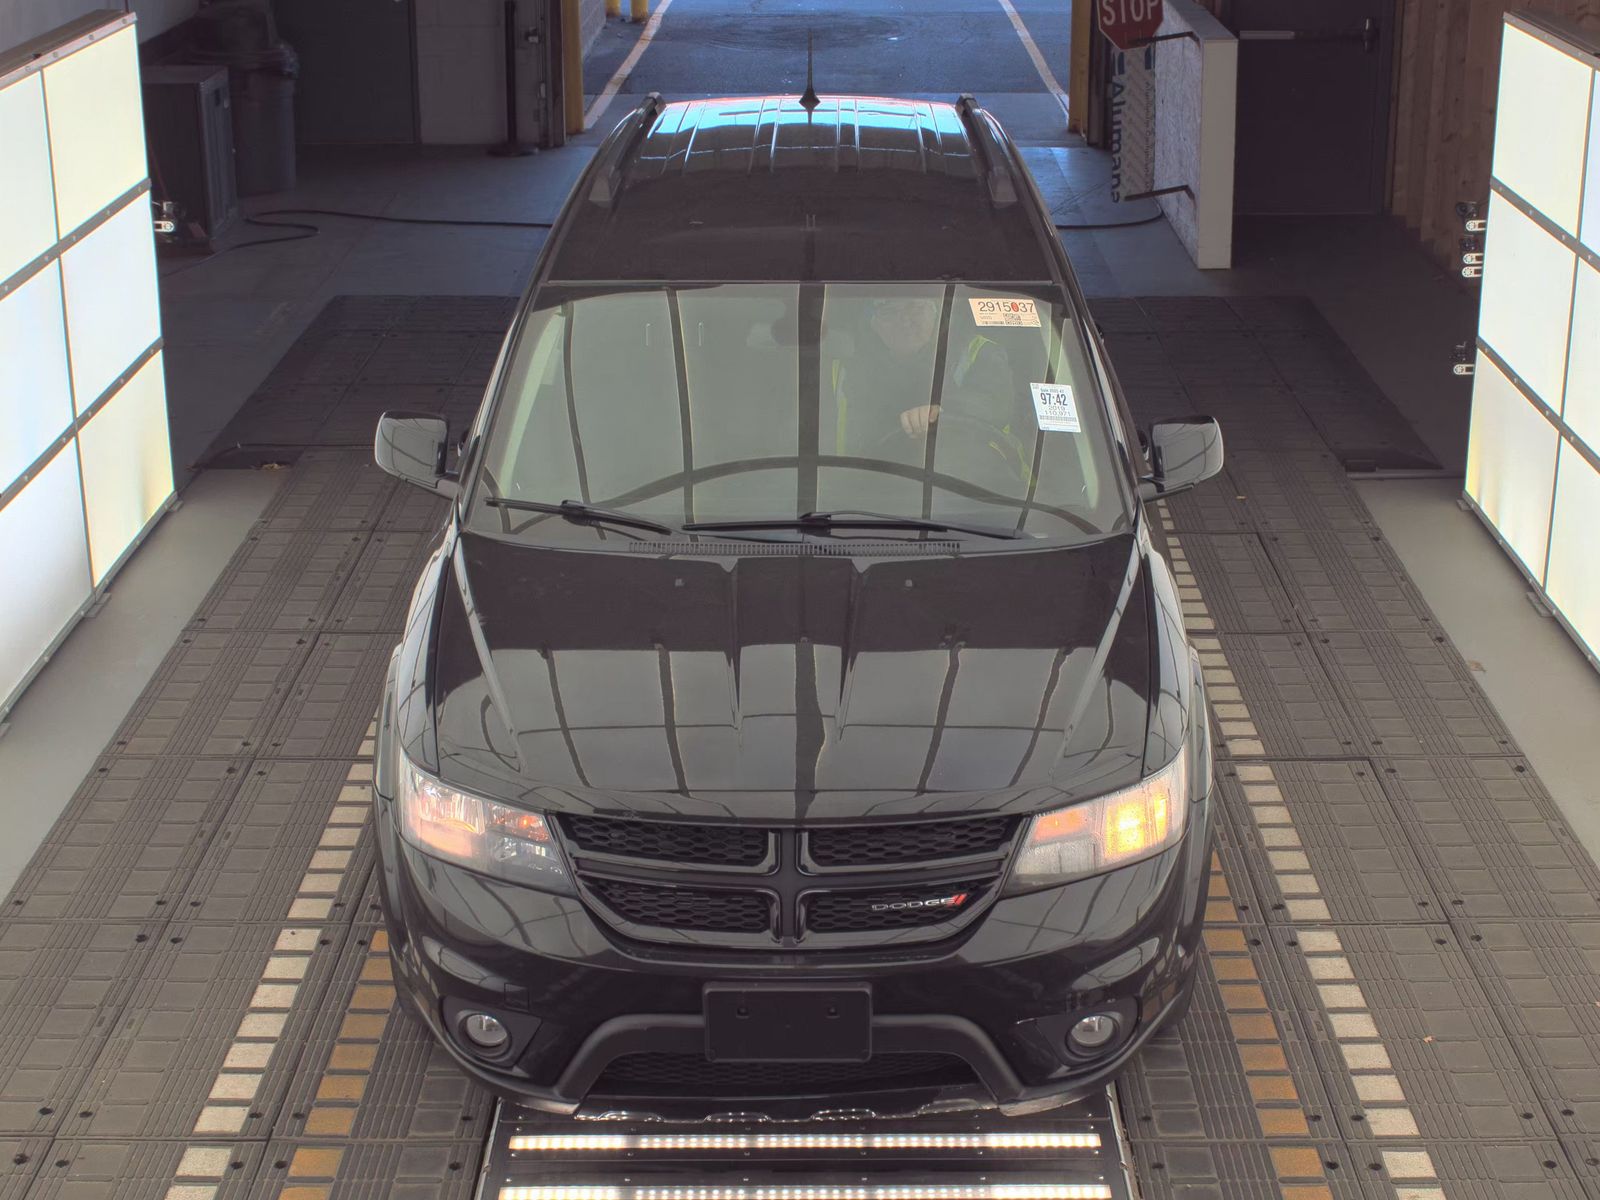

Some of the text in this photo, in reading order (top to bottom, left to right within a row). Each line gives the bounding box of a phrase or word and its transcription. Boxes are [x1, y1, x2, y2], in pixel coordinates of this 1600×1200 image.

[1102, 0, 1159, 25] STOP
[978, 301, 1034, 313] 2915037
[1040, 393, 1068, 406] 97:42
[872, 897, 952, 911] DODGE
